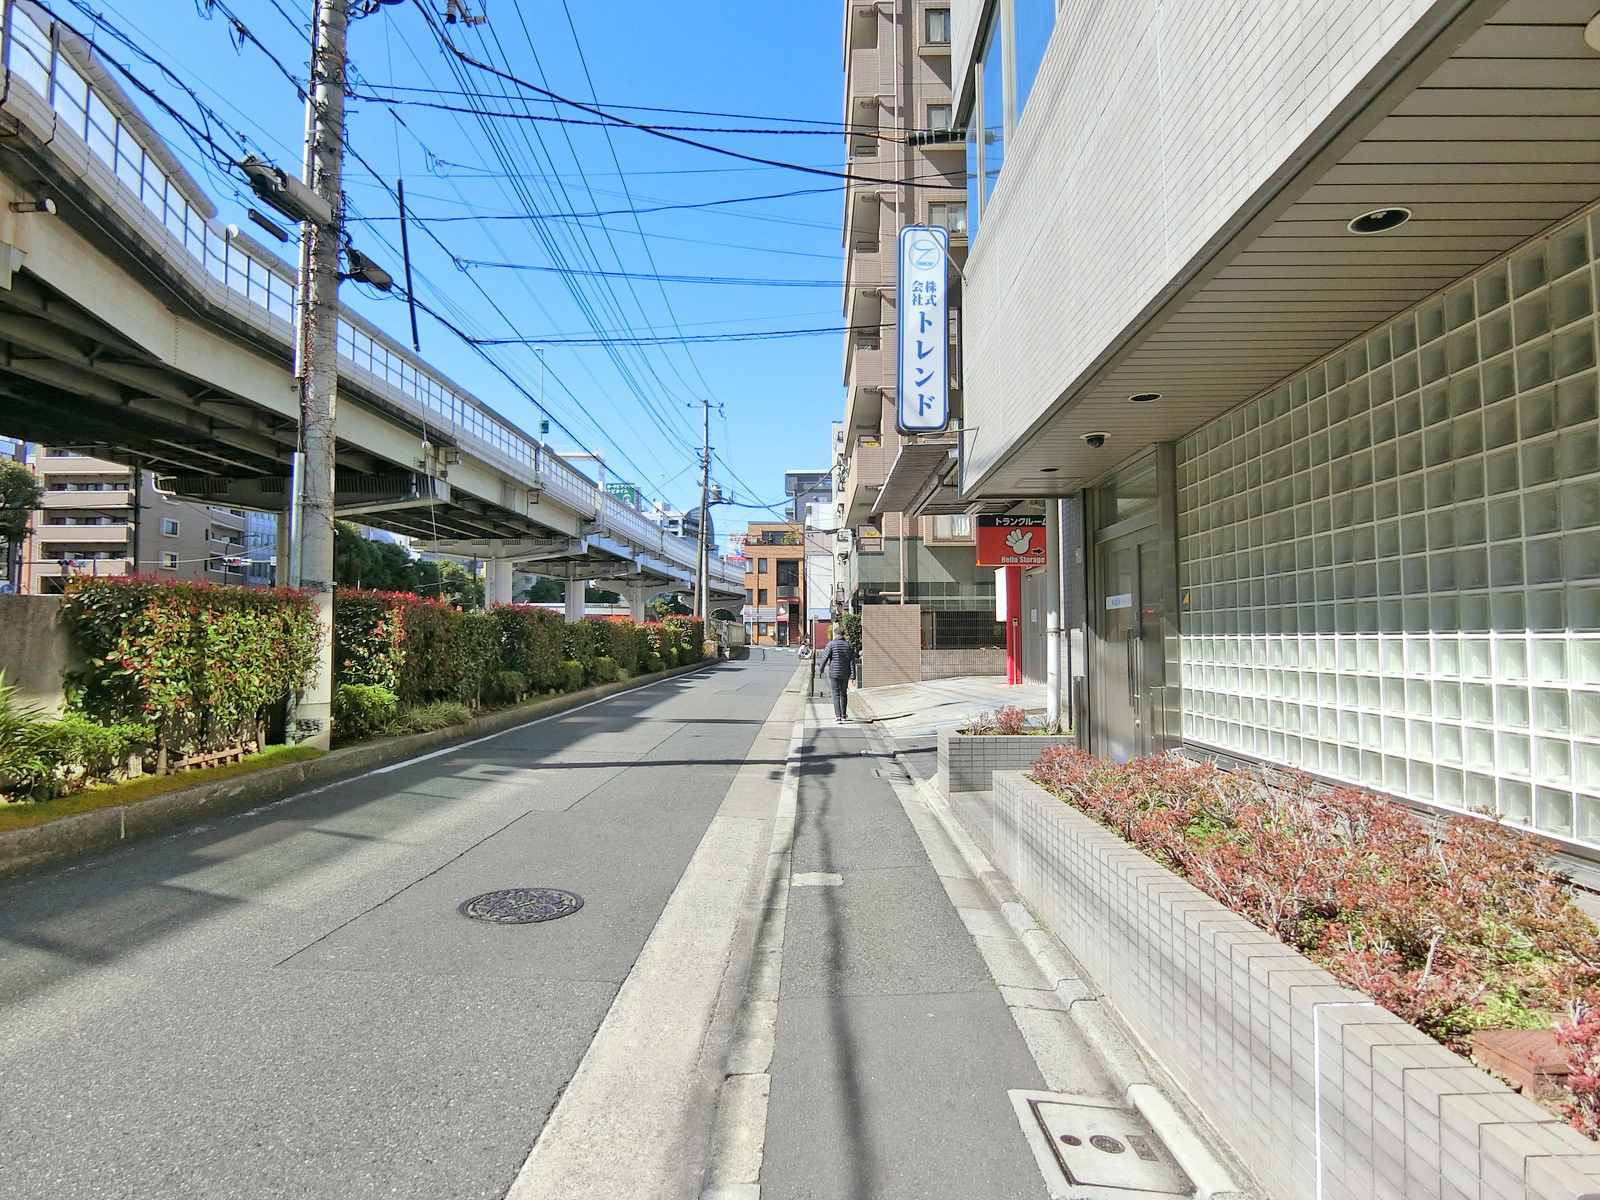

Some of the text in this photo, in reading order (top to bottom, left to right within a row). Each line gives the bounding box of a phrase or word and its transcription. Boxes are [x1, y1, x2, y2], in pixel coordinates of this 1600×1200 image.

[912, 280, 937, 307] 株式会社
[915, 311, 936, 417] トレンド
[1001, 556, 1045, 564] Hello Storage
